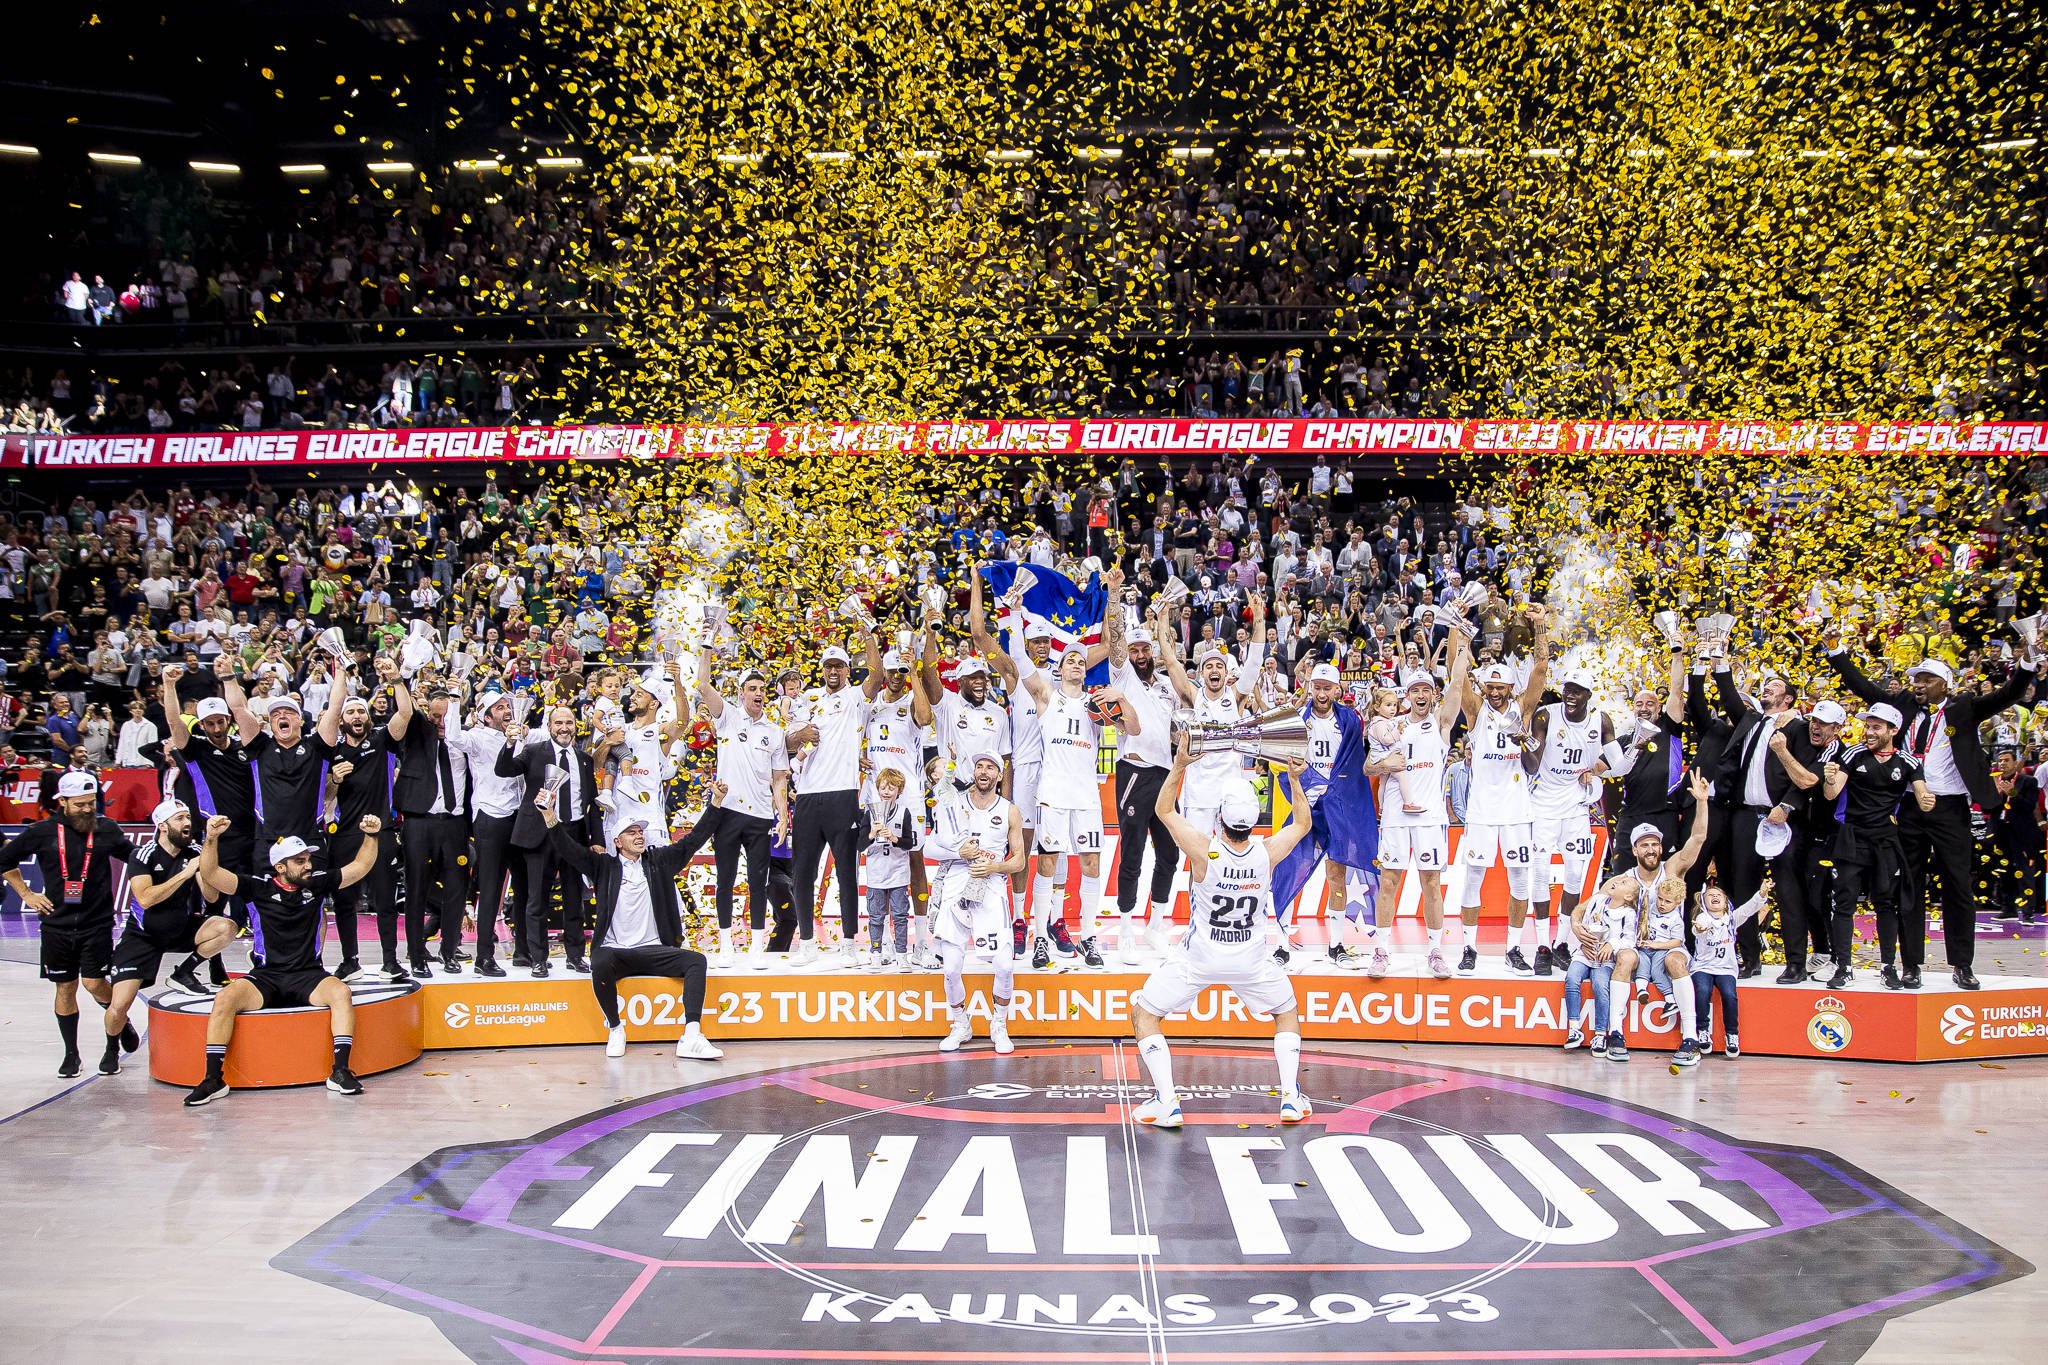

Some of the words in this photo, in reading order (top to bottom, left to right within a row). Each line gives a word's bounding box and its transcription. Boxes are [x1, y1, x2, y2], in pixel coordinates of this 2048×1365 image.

[19, 437, 155, 464] TURKISH
[162, 435, 298, 463] AIRLINES
[306, 431, 507, 459] EUROLEAGUE
[515, 428, 673, 456] CHAMPION
[1080, 423, 1293, 449] EUROLEAGUE
[1302, 422, 1463, 449] CHAMPION
[1574, 424, 1707, 450] TURKISH
[1866, 425, 2048, 451] EUROLEAGU
[1341, 671, 1373, 681] ONACO
[879, 724, 889, 740] 3
[1066, 718, 1081, 735] 11
[1051, 737, 1092, 750] AUTOHERO
[1497, 732, 1506, 748] 8
[1315, 740, 1331, 757] 31
[1562, 748, 1582, 764] 30
[1088, 831, 1100, 848] 11
[1576, 837, 1592, 854] 30
[883, 844, 890, 857] 5
[1519, 846, 1529, 863] 8
[1223, 866, 1257, 880] LLULL
[1215, 881, 1261, 891] AUTOHERO
[1209, 895, 1259, 930] 23
[988, 932, 998, 951] 5
[1210, 928, 1252, 943] MADRID
[1714, 947, 1726, 959] 13
[474, 1003, 520, 1013] TURKISH
[522, 1002, 569, 1012] AIRLINES
[770, 990, 954, 1023] TURKISH
[966, 989, 1141, 1022] ARLINE
[1164, 990, 1450, 1027] UREAGUE
[1981, 1005, 2042, 1020] TURKISH
[474, 1014, 546, 1027] EuroLeague
[1980, 1021, 2048, 1040] EuroLea
[1045, 1091, 1231, 1101] EuroLegue
[552, 1132, 1161, 1255] FINAL
[1205, 1133, 1771, 1255] FOUR
[801, 1292, 1217, 1324] KAUNAS
[1247, 1292, 1500, 1324] 2023
